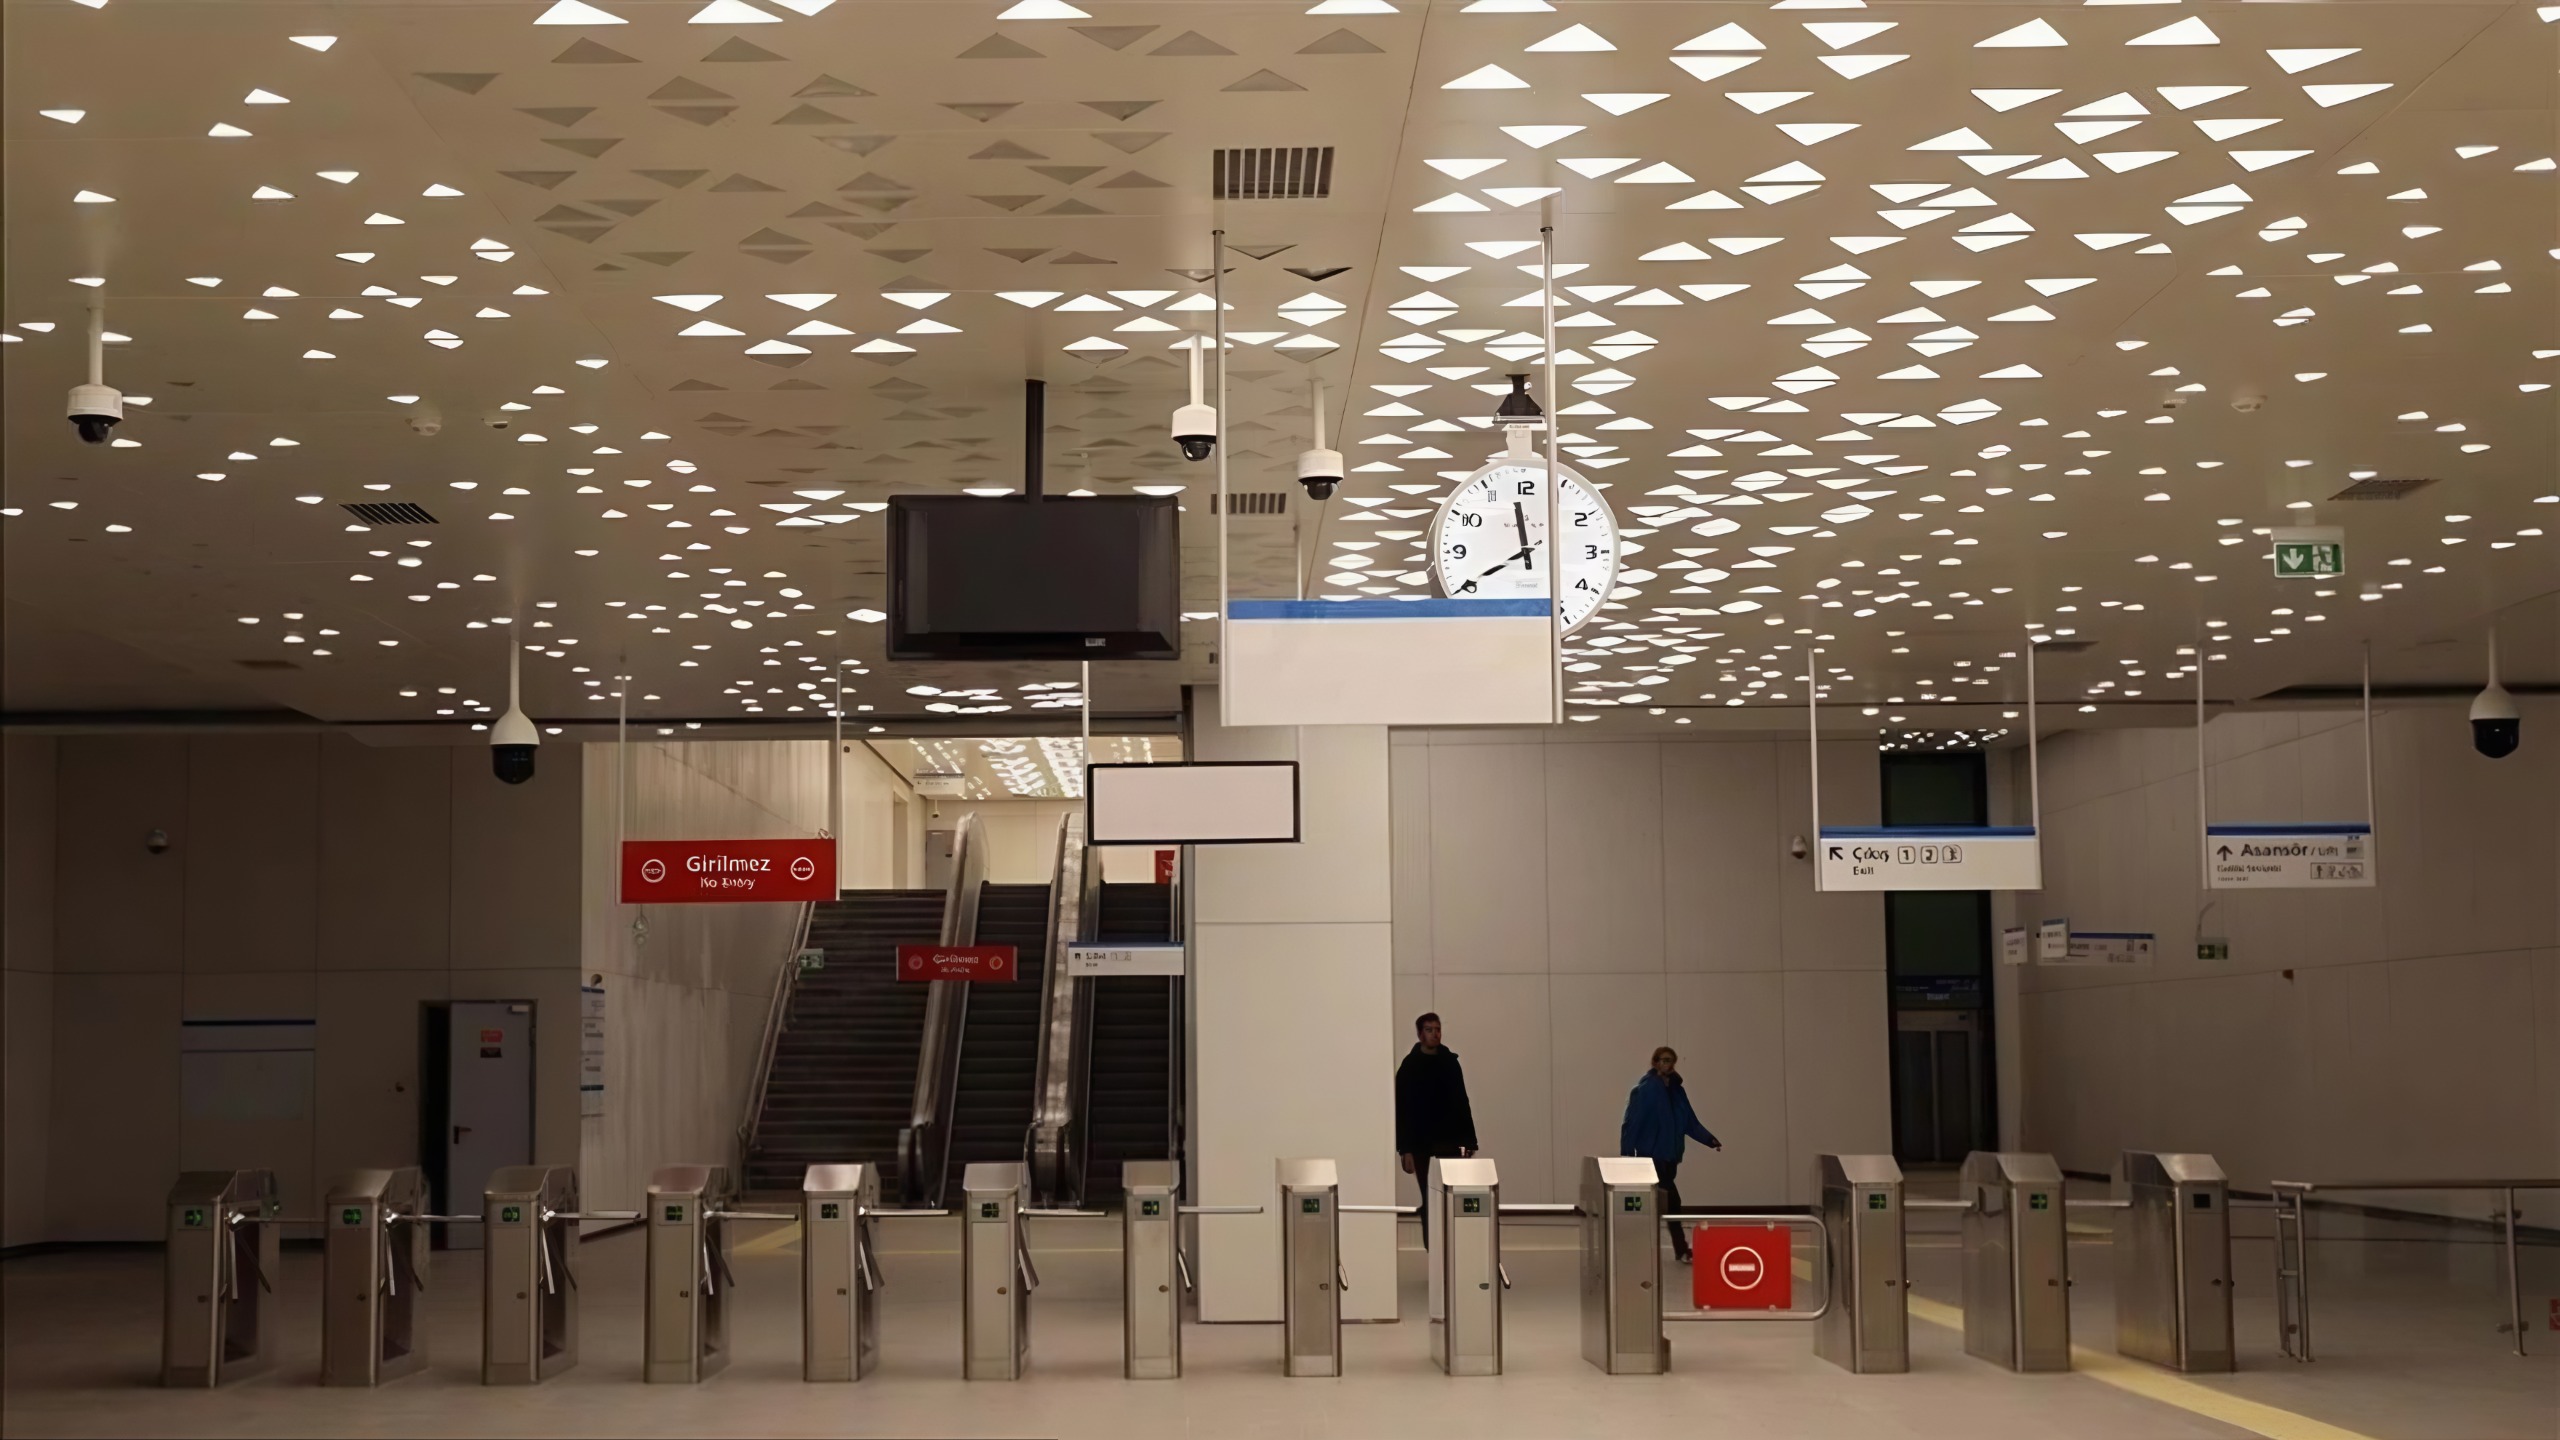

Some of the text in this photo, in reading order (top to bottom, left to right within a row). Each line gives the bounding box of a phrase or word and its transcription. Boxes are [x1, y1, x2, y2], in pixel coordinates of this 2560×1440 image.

[1517, 480, 1535, 495] 12
[1574, 512, 1588, 527] 2
[1452, 544, 1467, 559] 9
[1585, 545, 1598, 559] 3
[686, 854, 771, 872] Girilmez
